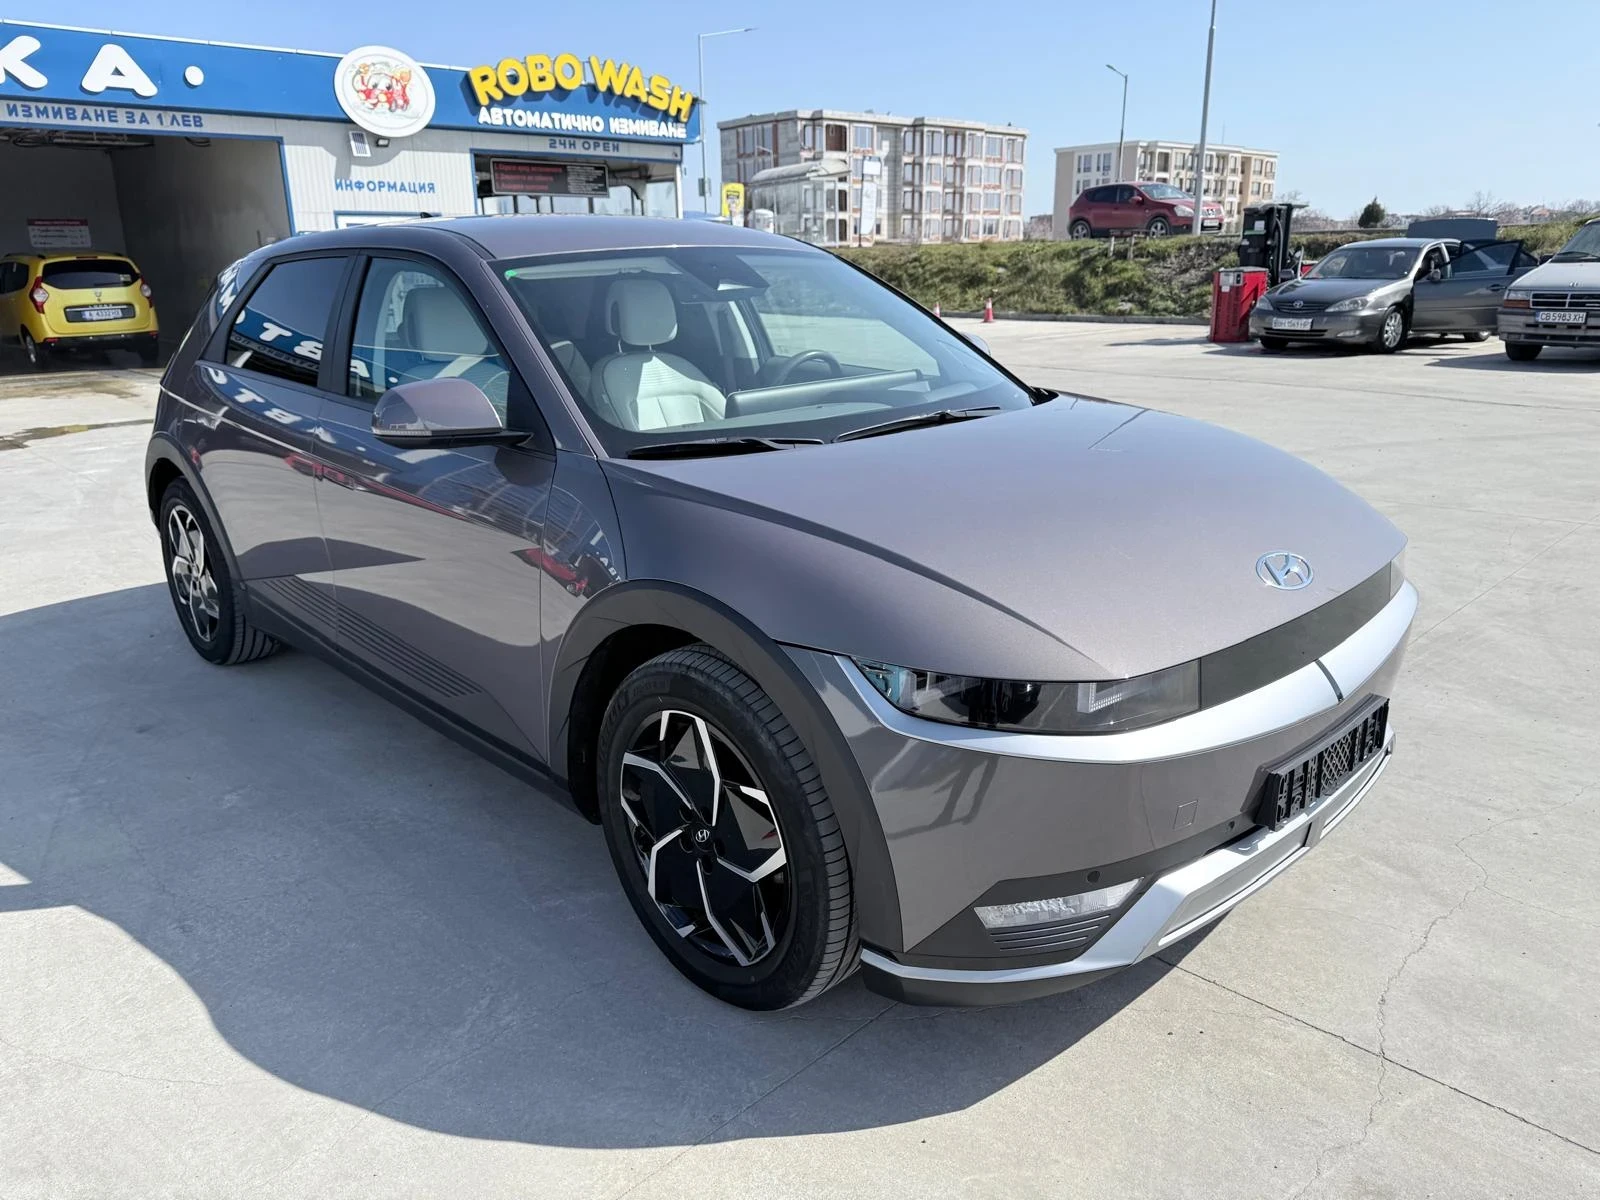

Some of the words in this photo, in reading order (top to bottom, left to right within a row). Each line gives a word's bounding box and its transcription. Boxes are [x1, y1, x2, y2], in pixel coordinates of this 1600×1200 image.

[469, 53, 583, 106] ROBO
[590, 56, 694, 122] WASH
[6, 103, 119, 123] ИЗМИВАНЕ
[126, 111, 150, 125] ЗА
[156, 113, 164, 126] 1
[169, 114, 204, 128] ЛЕВ
[478, 106, 604, 133] АВТОМАТИЧНО
[609, 117, 687, 139] ИЗМИВАНЕ
[334, 179, 436, 195] ИНФОРМАЦИЯ
